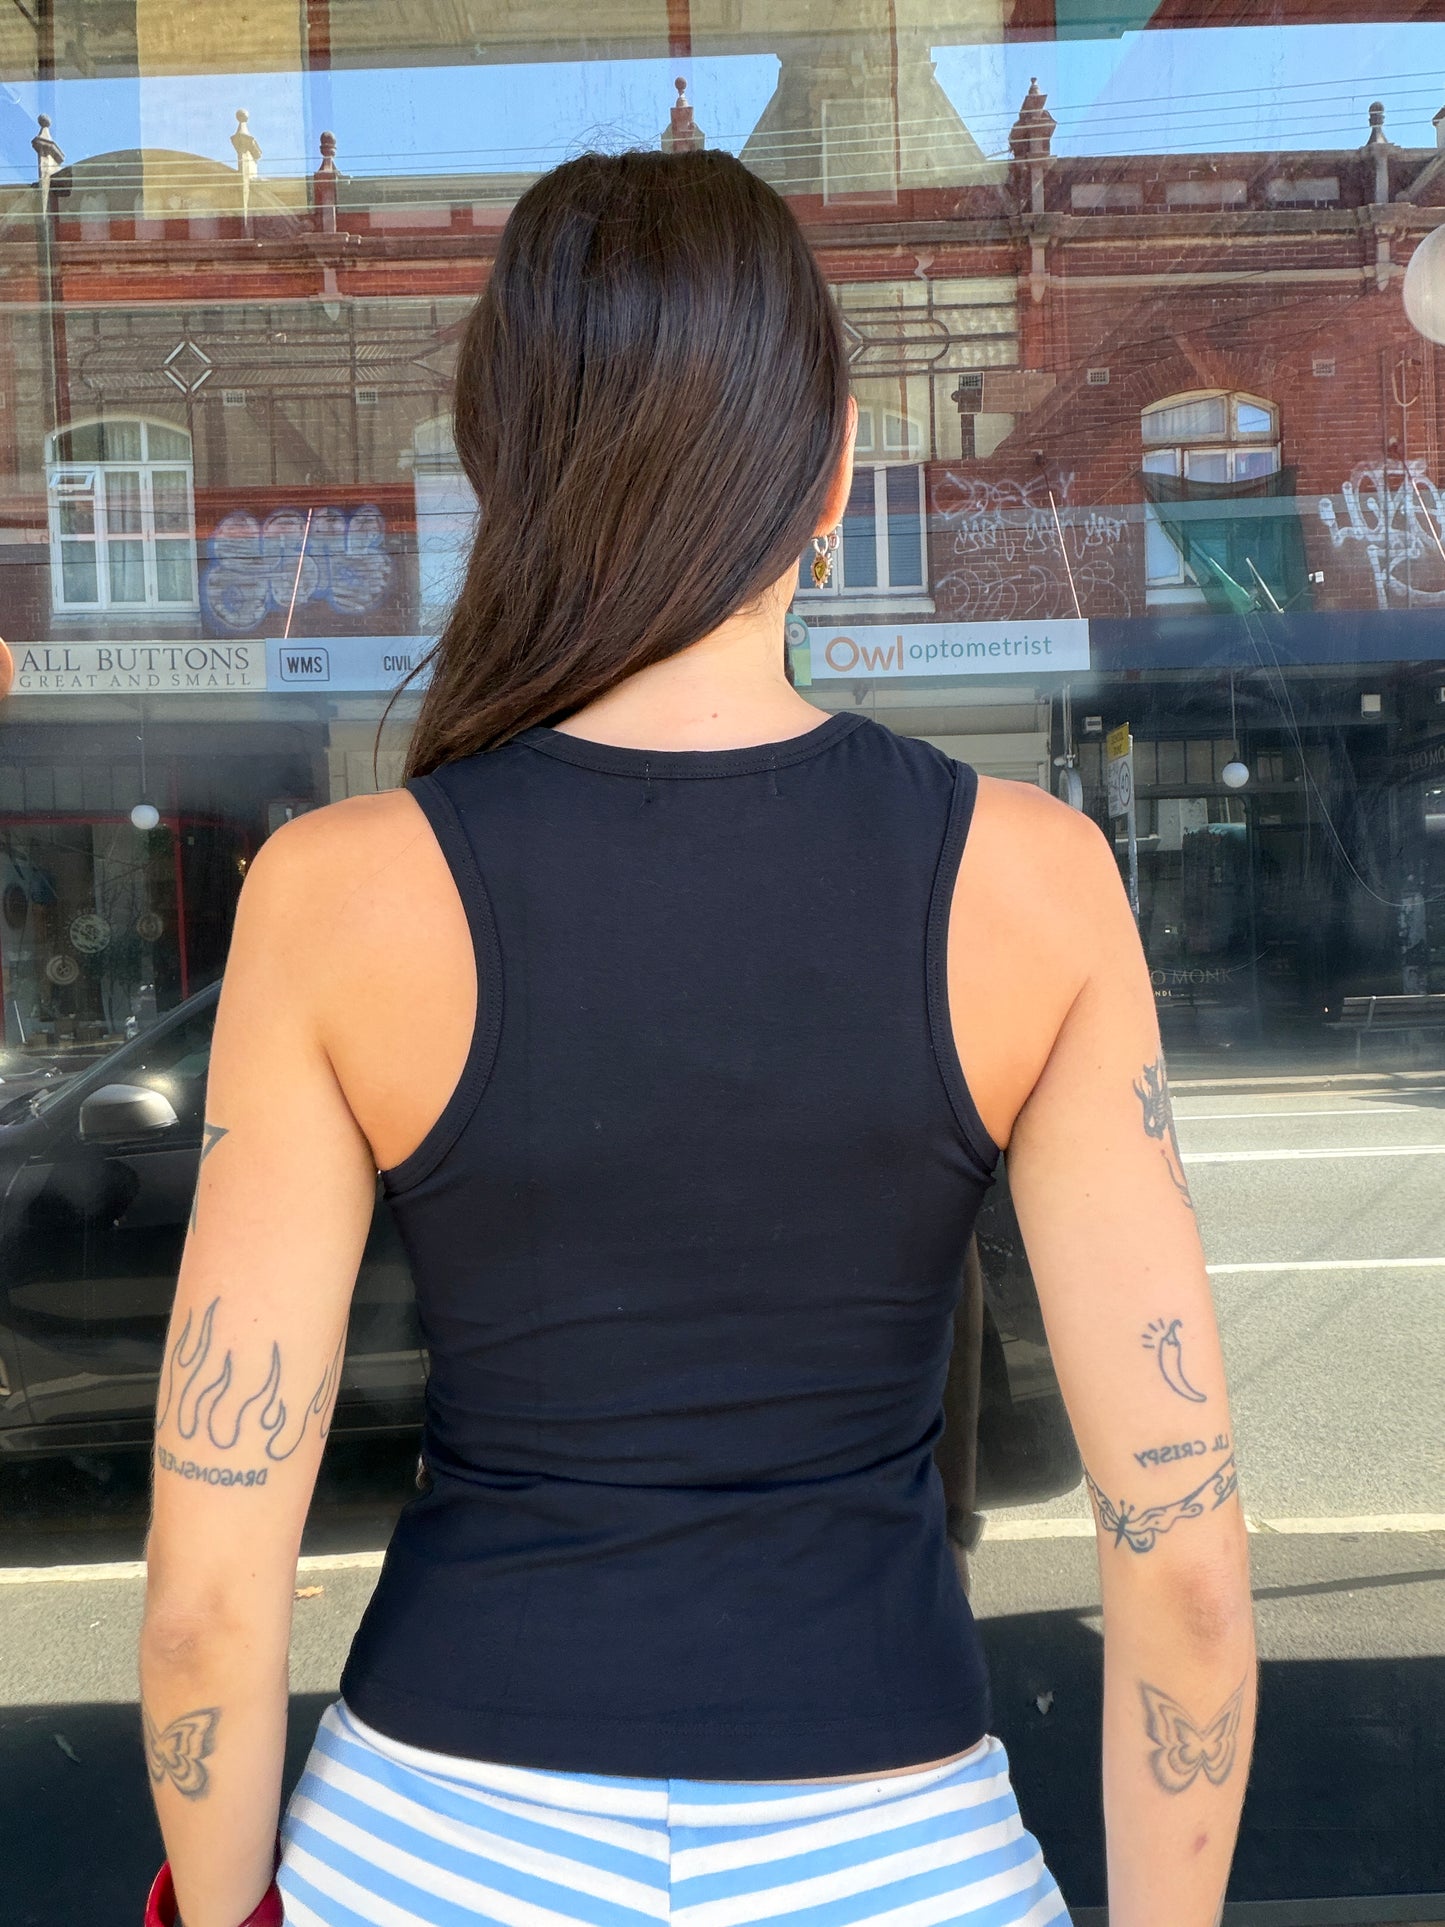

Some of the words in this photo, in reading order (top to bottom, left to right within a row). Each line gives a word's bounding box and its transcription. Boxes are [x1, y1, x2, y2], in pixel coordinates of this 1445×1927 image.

[19, 648, 81, 672] ALL
[96, 647, 250, 672] BUTTONS
[825, 635, 904, 672] Owl
[909, 635, 1053, 663] optometrist
[286, 656, 323, 674] WMS
[383, 655, 415, 672] CIVIL
[19, 675, 98, 688] GREAT
[109, 674, 161, 687] AND
[171, 673, 251, 687] SMALL
